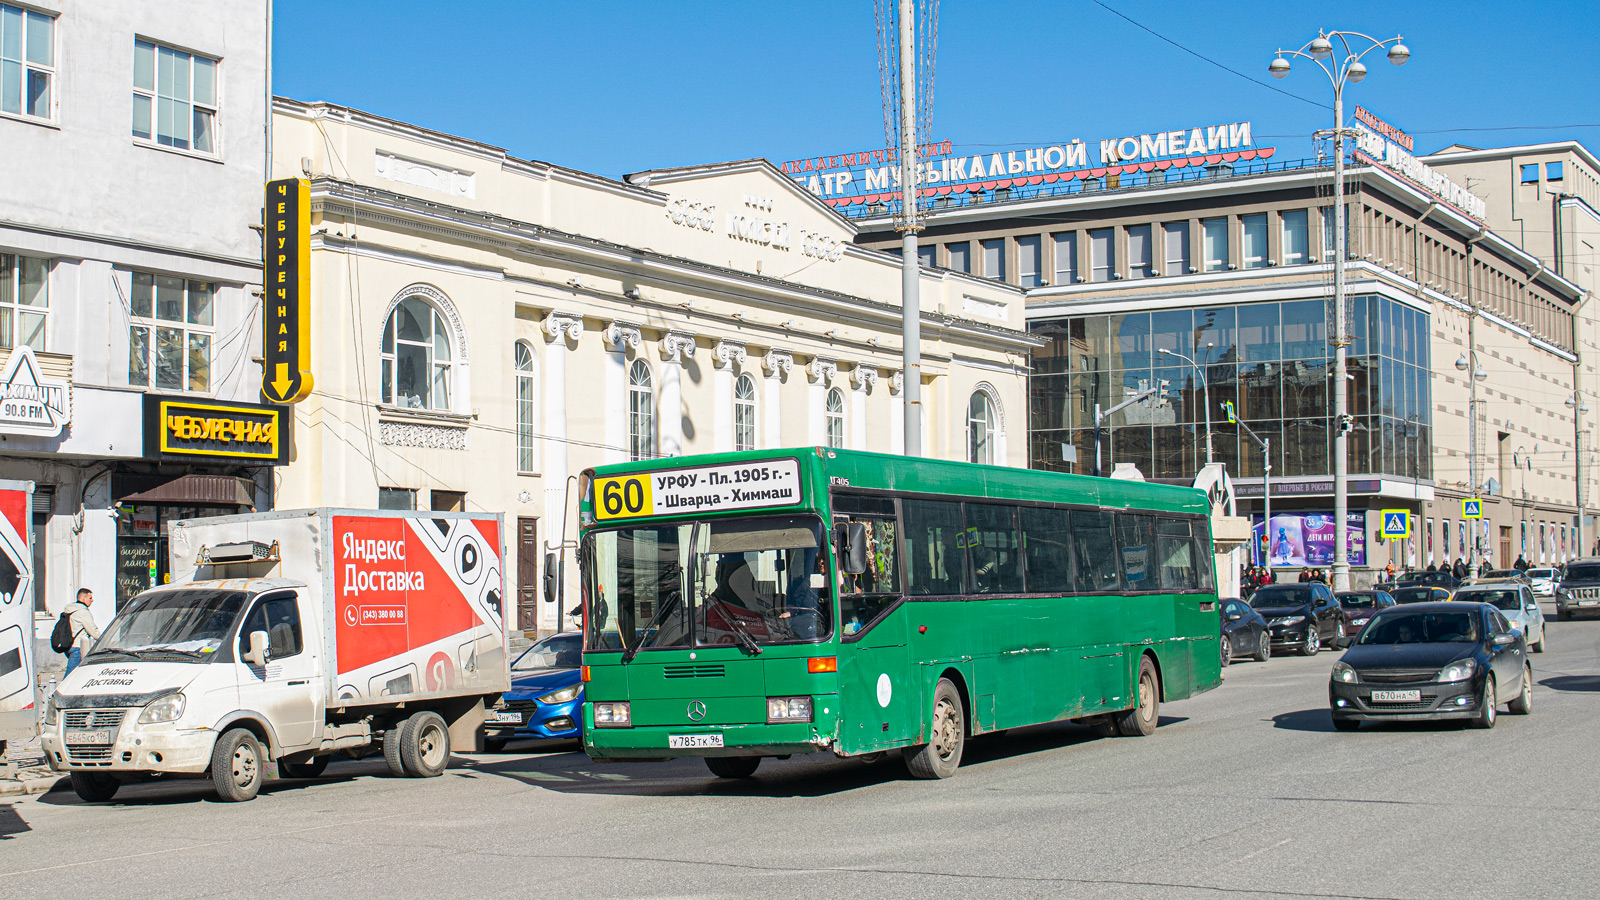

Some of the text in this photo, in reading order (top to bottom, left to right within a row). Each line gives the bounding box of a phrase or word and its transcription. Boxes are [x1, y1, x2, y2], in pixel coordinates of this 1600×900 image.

[1100, 121, 1251, 164] КОМЕДИИ
[780, 138, 952, 175] АКАДЕМИЧЕКИЙ
[277, 185, 288, 352] ЧЕБУРЕЧНАЯ
[5, 403, 42, 419] 90.8 FM
[167, 415, 273, 443] ЧЕБУРЕЧНАЯ
[657, 473, 698, 490] УРФУ
[772, 470, 782, 480] г.
[603, 478, 644, 515] 60
[665, 494, 721, 509] Шварца
[732, 487, 793, 503] Химмаш
[1307, 518, 1315, 526] 35
[342, 532, 405, 563] Яндекс
[1307, 533, 1335, 542] ДЕТИ ИГР
[343, 564, 425, 596] Доставка
[363, 610, 404, 621] (343) 380 00 88
[98, 668, 138, 676] Яндекс
[81, 678, 134, 689] Доставка
